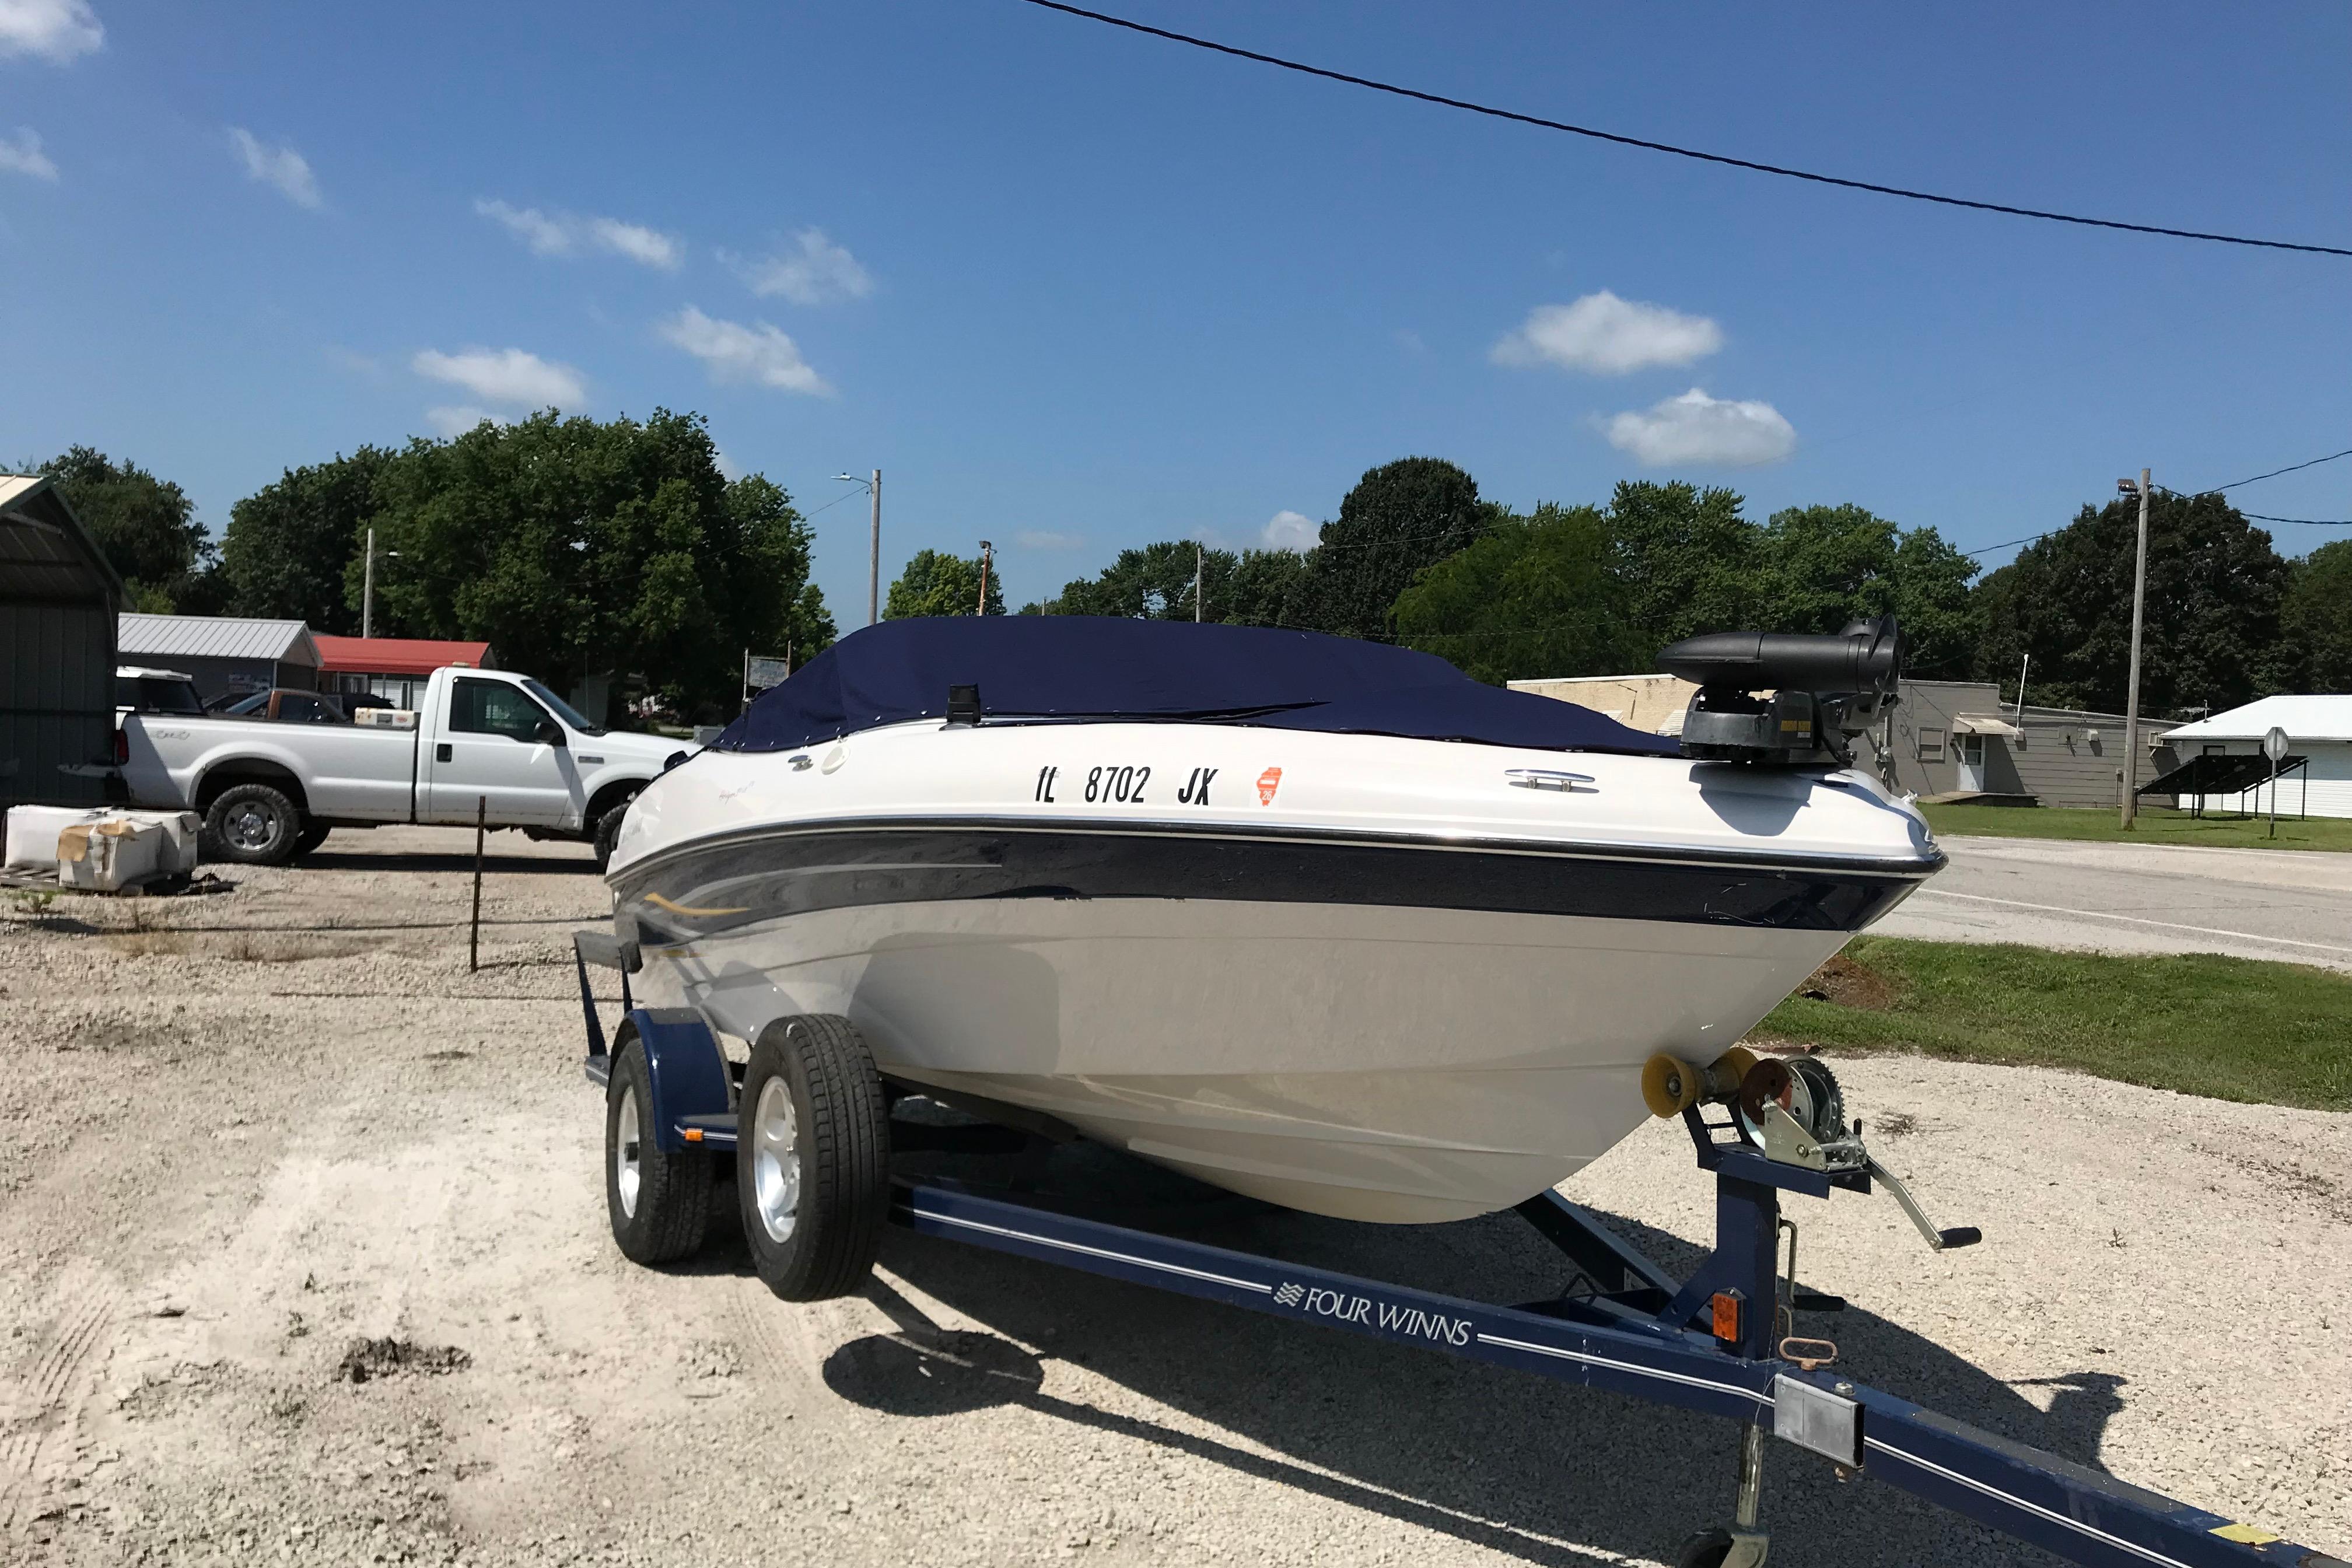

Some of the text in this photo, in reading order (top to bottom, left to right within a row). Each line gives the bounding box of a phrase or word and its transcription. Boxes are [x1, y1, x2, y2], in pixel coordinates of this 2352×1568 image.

[1035, 766, 1058, 803] IL
[1085, 766, 1151, 803] 8702
[1261, 790, 1273, 800] 26
[1304, 1287, 1474, 1346] FOUR WINNS
